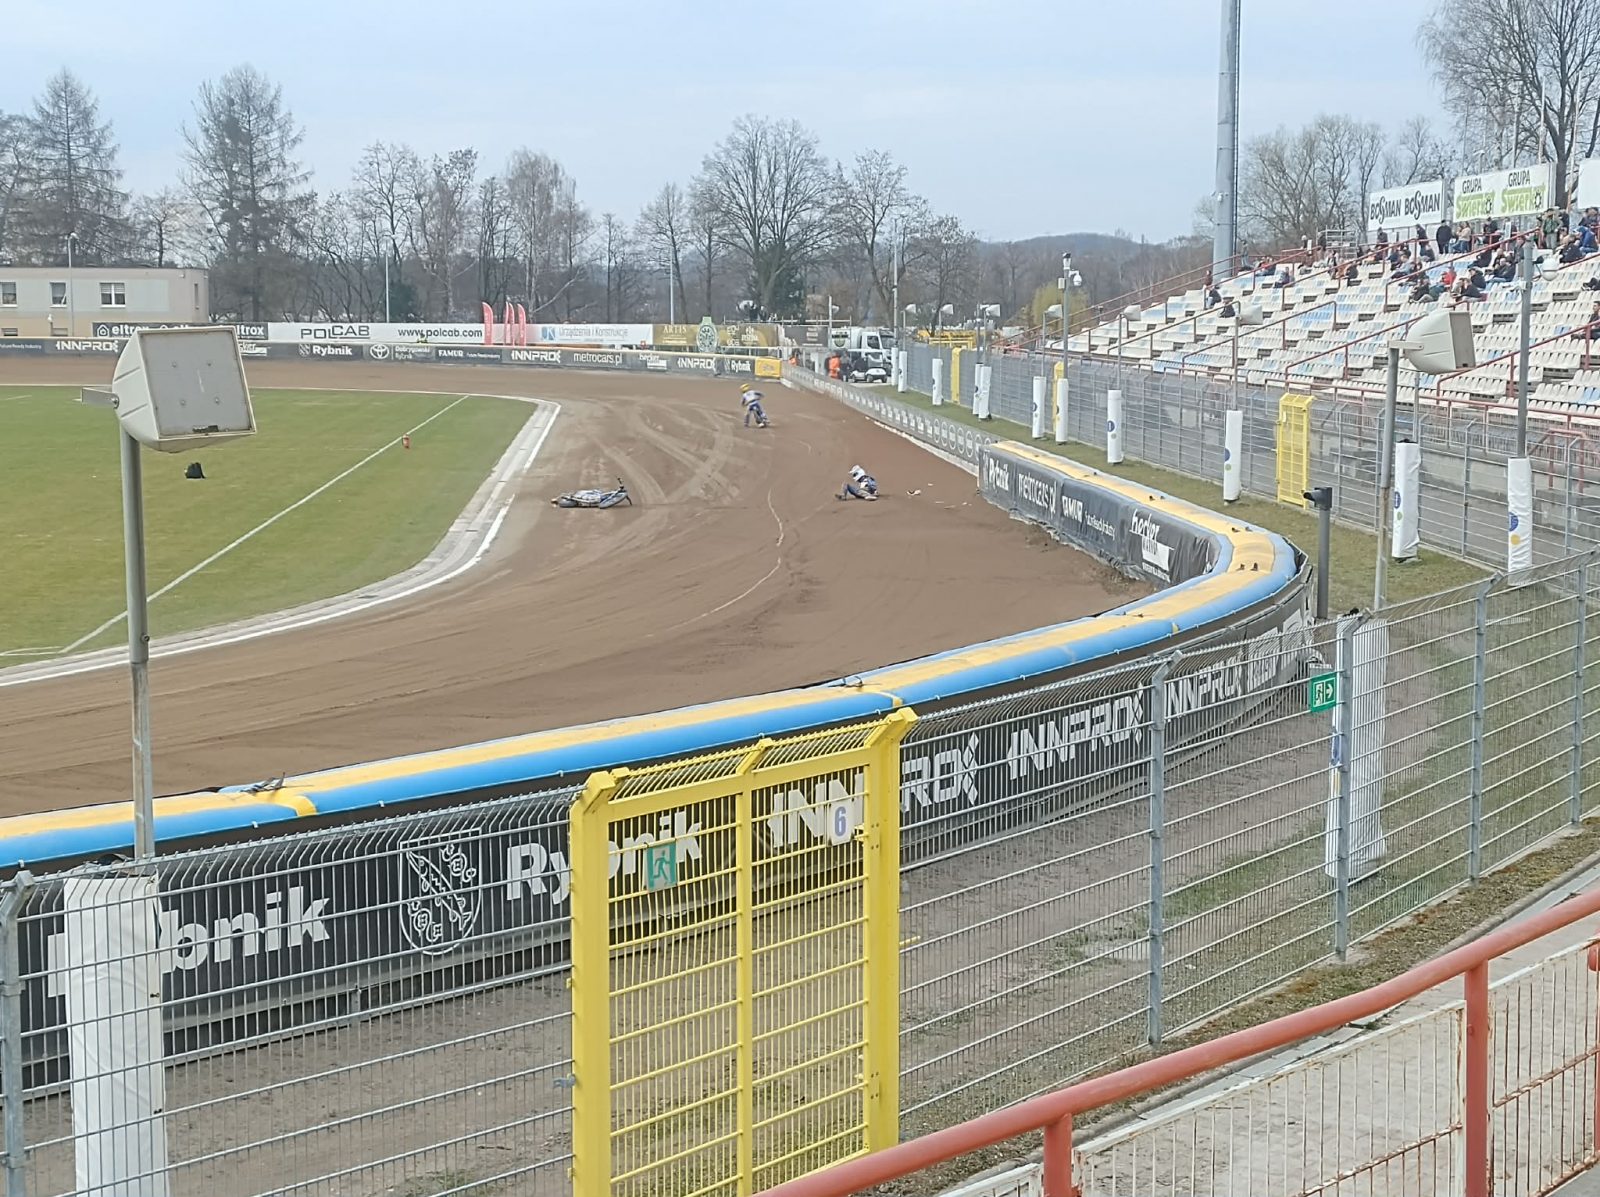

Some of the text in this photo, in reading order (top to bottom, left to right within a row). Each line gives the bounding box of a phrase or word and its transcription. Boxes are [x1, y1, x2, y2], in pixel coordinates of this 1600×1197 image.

[1506, 169, 1531, 187] GRUPA
[1462, 178, 1482, 194] GRUPA
[236, 324, 264, 336] ltrox
[300, 325, 370, 339] POLCAB
[397, 327, 483, 338] www.polcab.com
[663, 325, 687, 334] ARTIS
[312, 345, 352, 357] Rybnik
[438, 349, 464, 357] FAMUR
[573, 352, 623, 366] metrocars.pl
[834, 805, 848, 838] 6
[506, 811, 703, 906] Rynk
